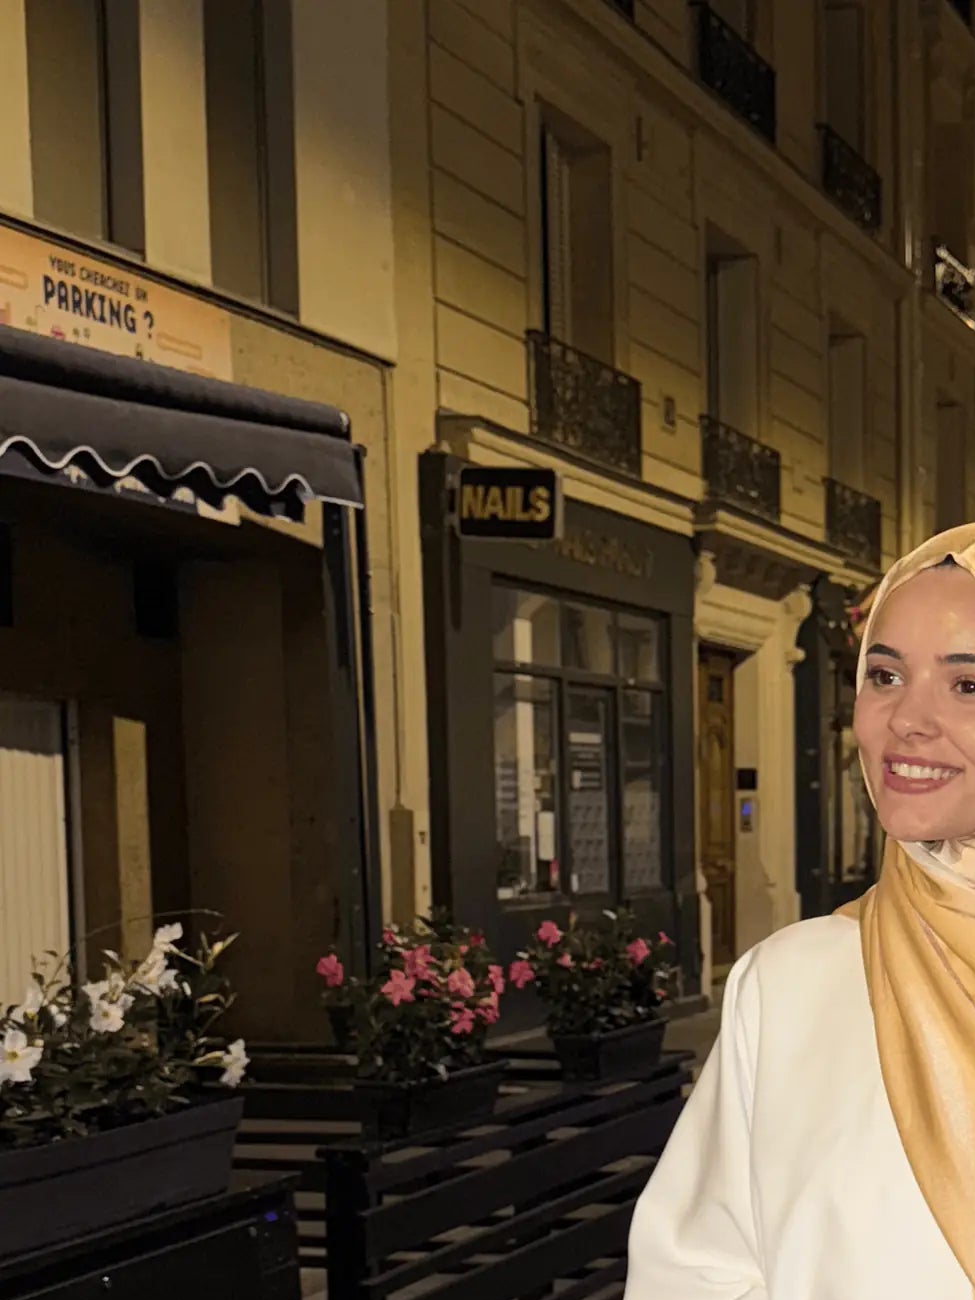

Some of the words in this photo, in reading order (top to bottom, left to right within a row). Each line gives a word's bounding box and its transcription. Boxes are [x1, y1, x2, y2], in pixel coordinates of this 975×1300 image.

[50, 256, 76, 277] VOUS
[80, 267, 130, 297] CHERCHEZ
[43, 275, 137, 333] PARKING
[461, 484, 550, 522] NAILS
